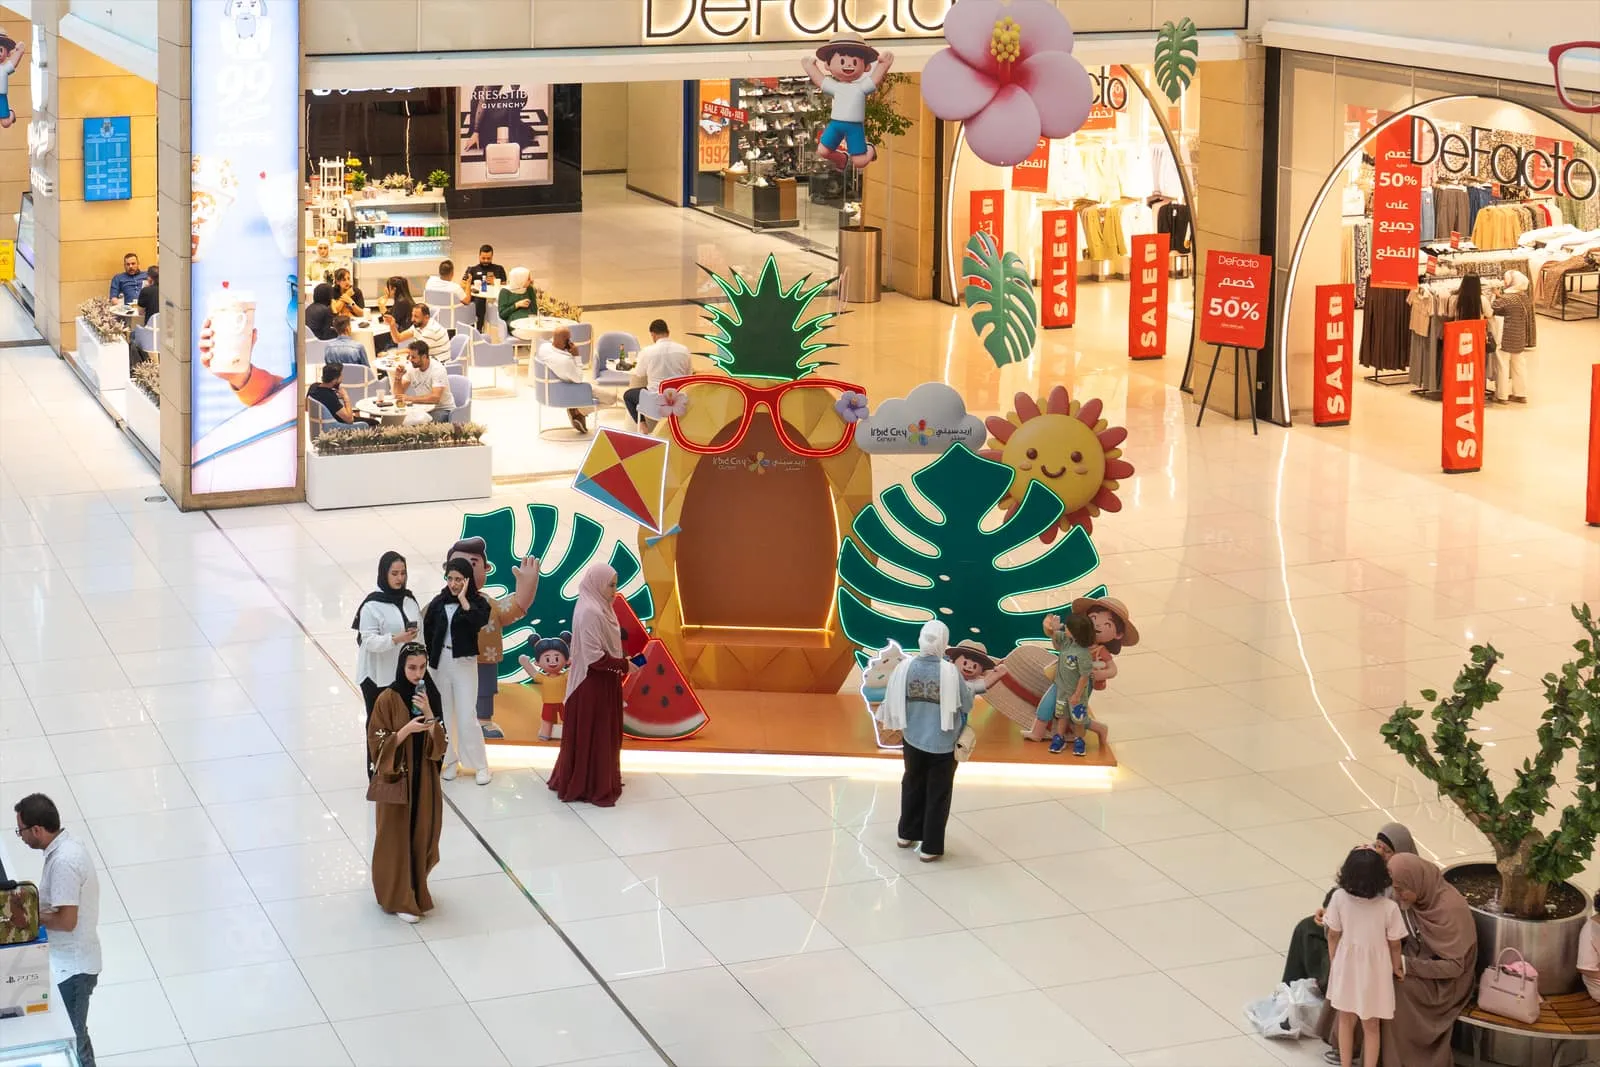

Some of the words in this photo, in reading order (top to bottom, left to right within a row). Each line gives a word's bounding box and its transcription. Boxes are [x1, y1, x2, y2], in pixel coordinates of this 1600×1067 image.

[703, 103, 720, 115] SALE
[699, 145, 729, 165] 1992
[1384, 148, 1412, 161] خصم
[1409, 114, 1598, 201] DeFacto
[1378, 171, 1418, 187] 50%
[1385, 200, 1409, 210] على
[1378, 220, 1415, 234] جميع
[1375, 246, 1416, 261] القطع
[1218, 255, 1260, 269] DeFacto
[1053, 241, 1069, 318] SALE
[1217, 276, 1256, 289] خصم
[1141, 267, 1159, 348] SALE
[1208, 297, 1260, 321] 50%
[1326, 321, 1344, 414] SALE
[1456, 362, 1477, 459] SALE
